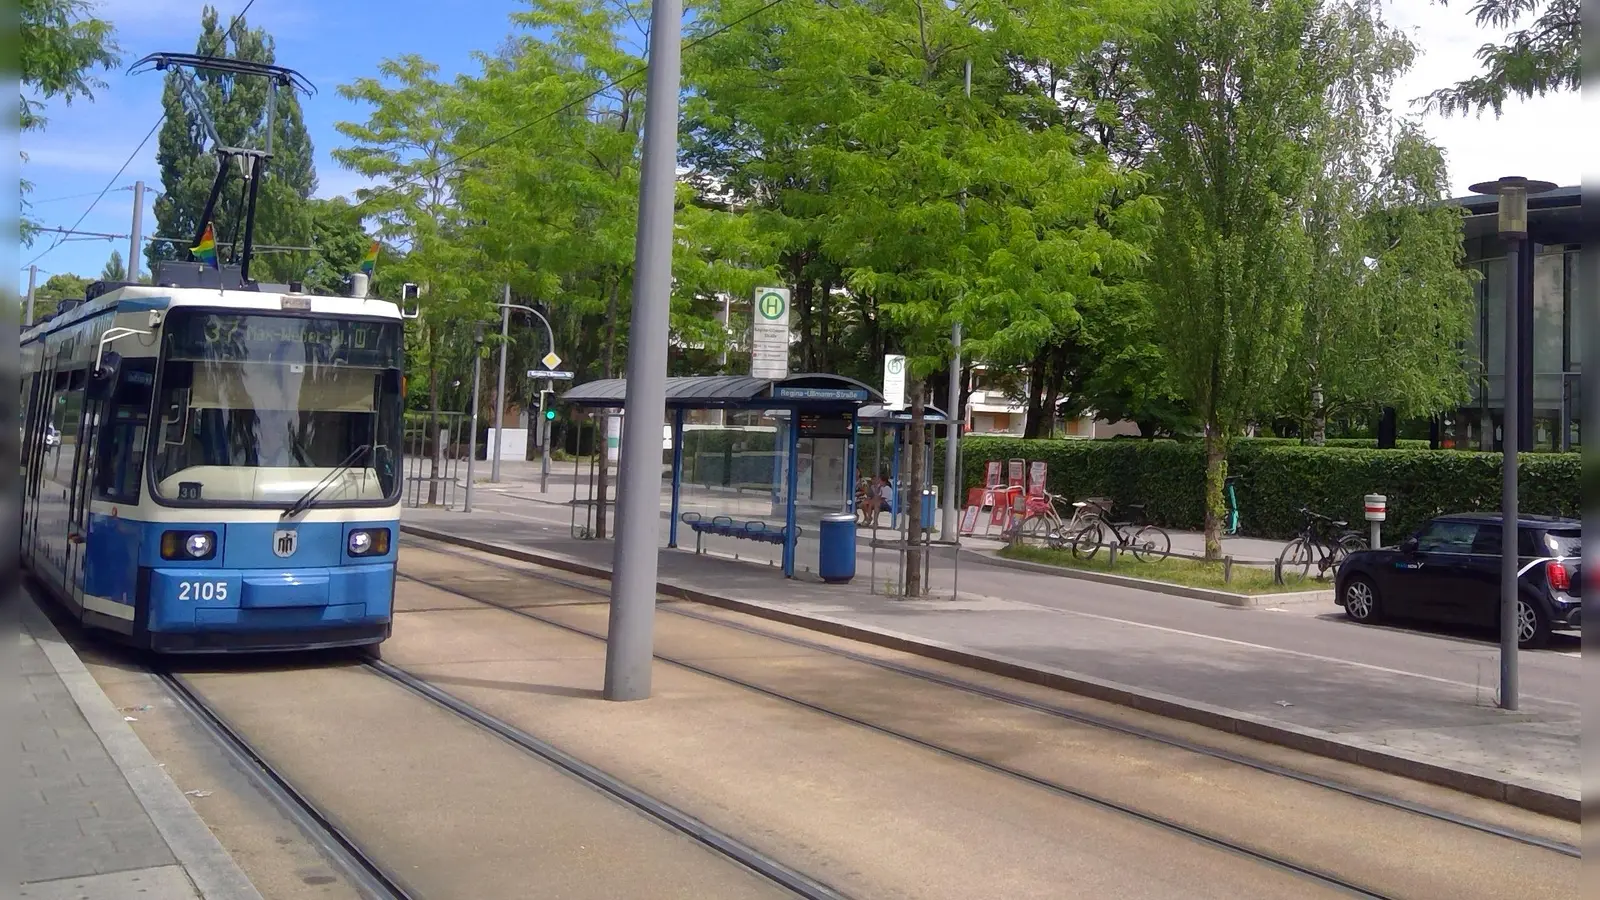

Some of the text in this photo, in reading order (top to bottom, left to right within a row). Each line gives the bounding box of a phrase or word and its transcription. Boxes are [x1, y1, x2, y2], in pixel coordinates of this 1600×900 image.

[766, 298, 778, 315] H
[180, 487, 197, 499] 30
[179, 582, 228, 601] 2105
